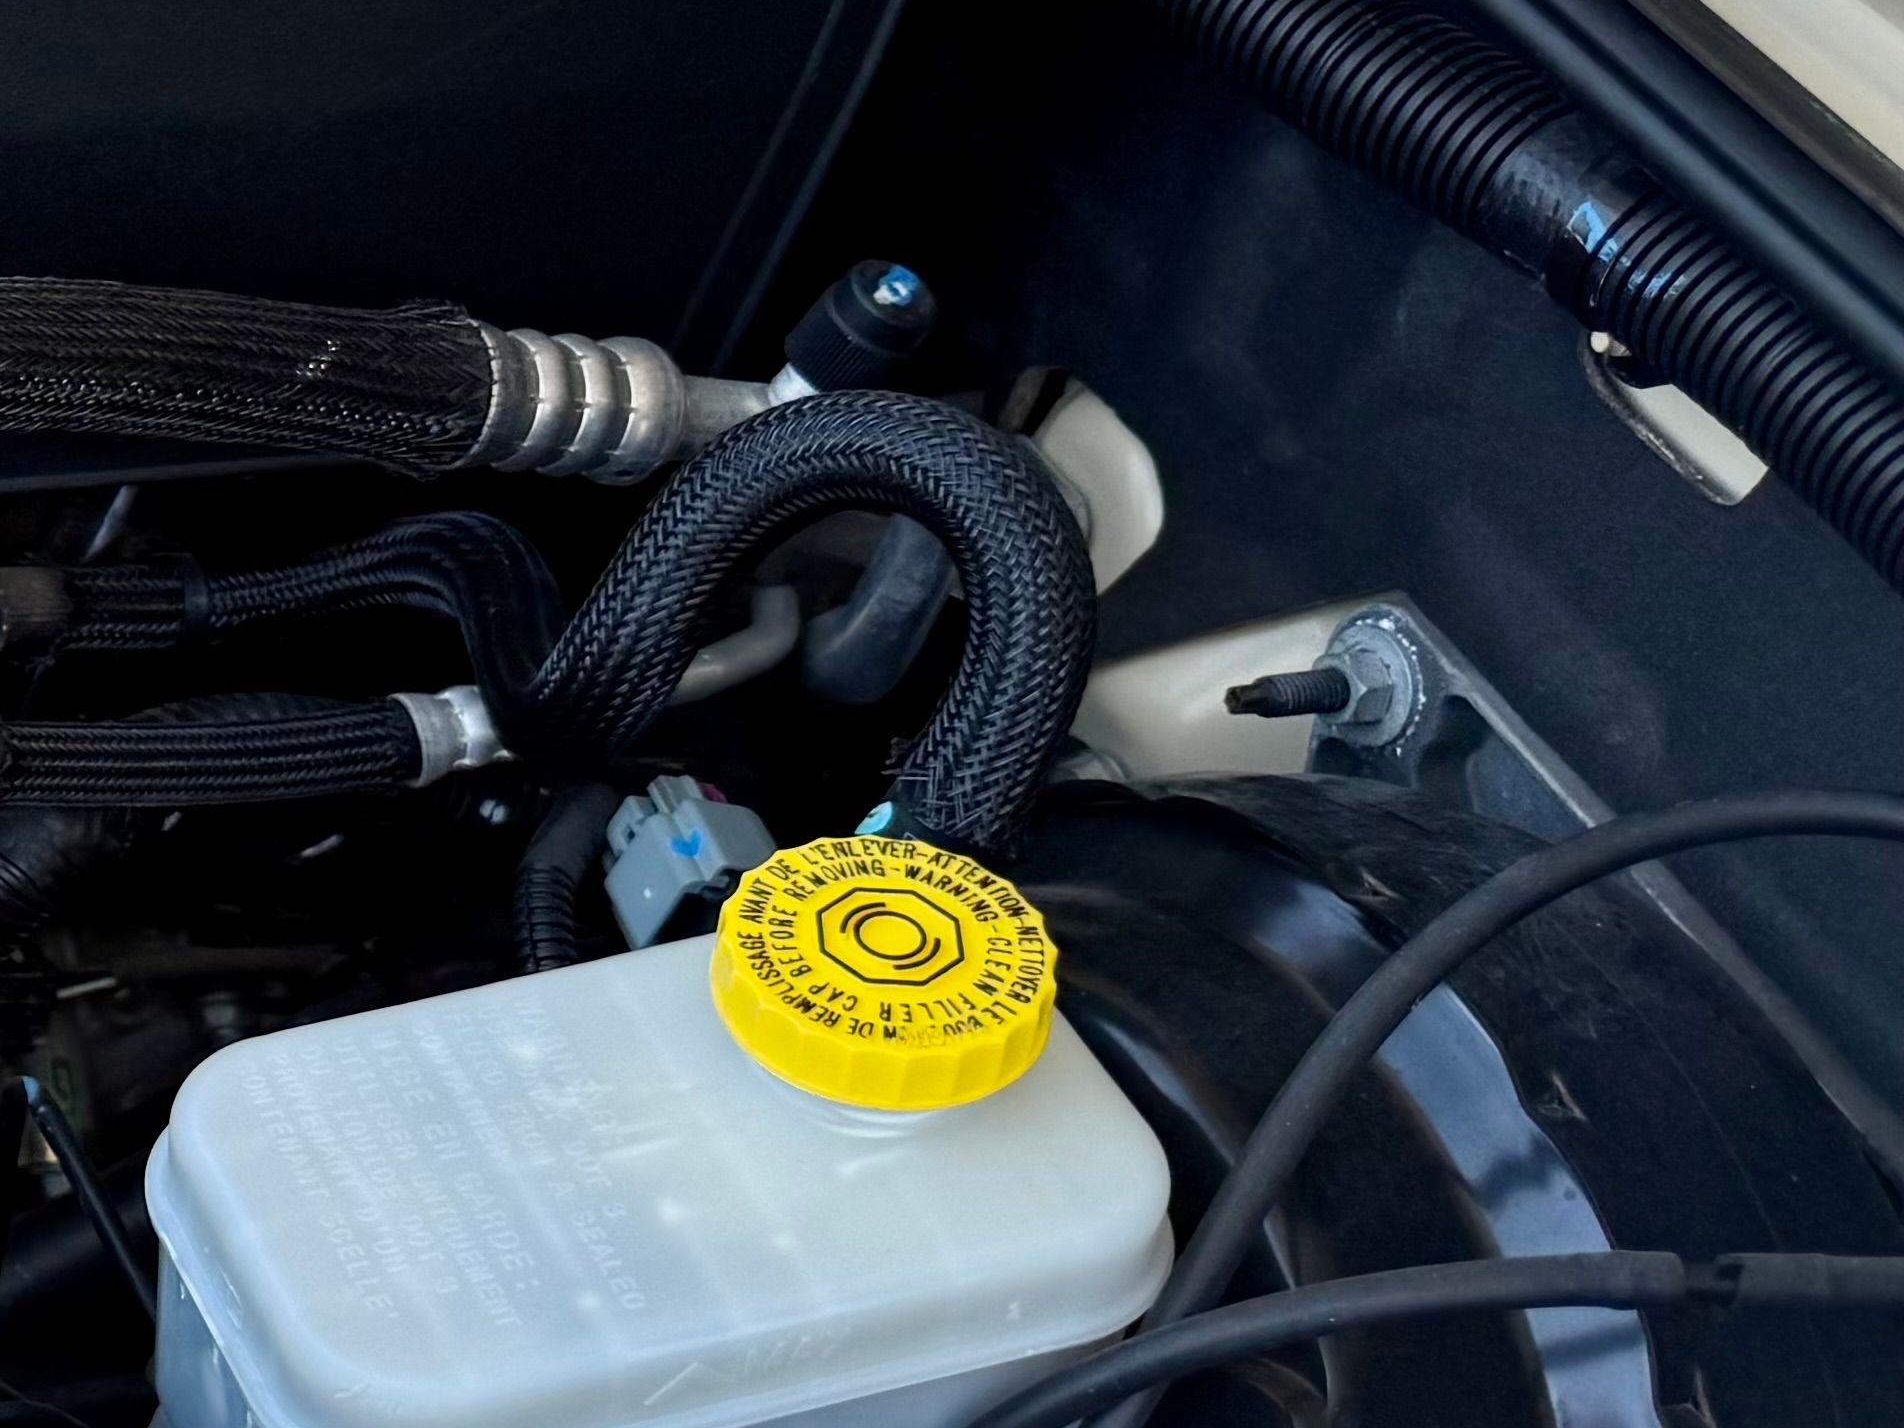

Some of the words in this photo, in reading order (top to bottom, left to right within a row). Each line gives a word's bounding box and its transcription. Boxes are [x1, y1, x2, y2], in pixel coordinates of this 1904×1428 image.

[768, 856, 801, 882] DE
[739, 877, 779, 924] AVANT
[768, 906, 813, 978] BEFORE
[972, 937, 1013, 997] CLEAN
[808, 981, 860, 1012] CAP
[879, 991, 978, 1023] FILLER
[846, 1017, 875, 1039] DE
[418, 1121, 470, 1160] EN
